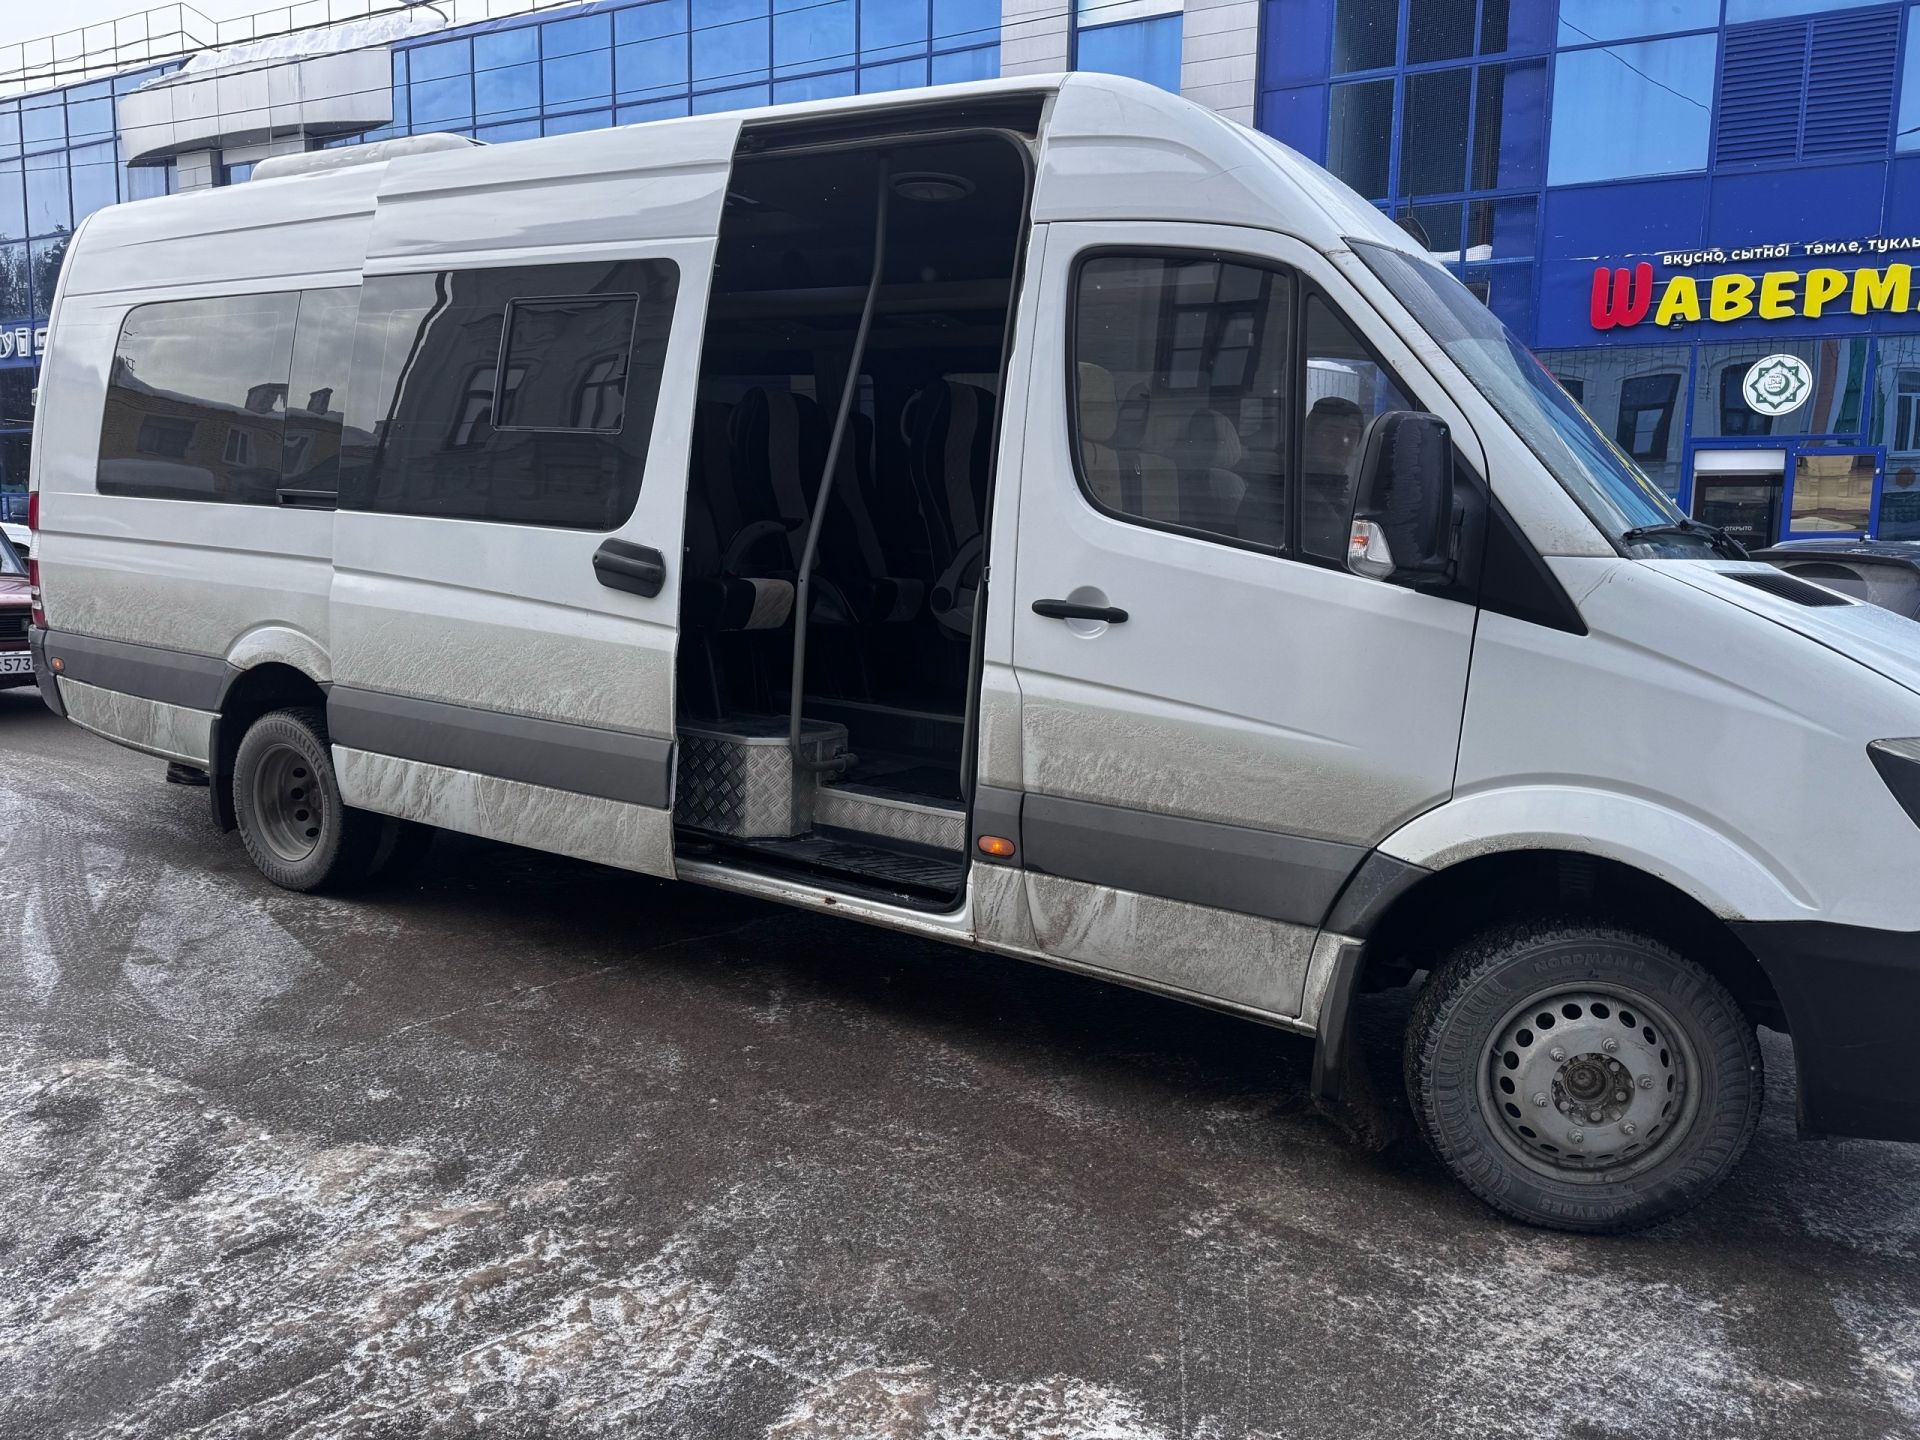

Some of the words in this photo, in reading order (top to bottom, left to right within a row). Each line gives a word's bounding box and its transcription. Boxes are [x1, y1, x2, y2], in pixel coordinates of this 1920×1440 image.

[1663, 251, 1727, 267] вкусно,
[1731, 244, 1790, 260] сытно!
[1804, 241, 1863, 255] тәмле,
[1590, 261, 1920, 330] ШАВЕРМ
